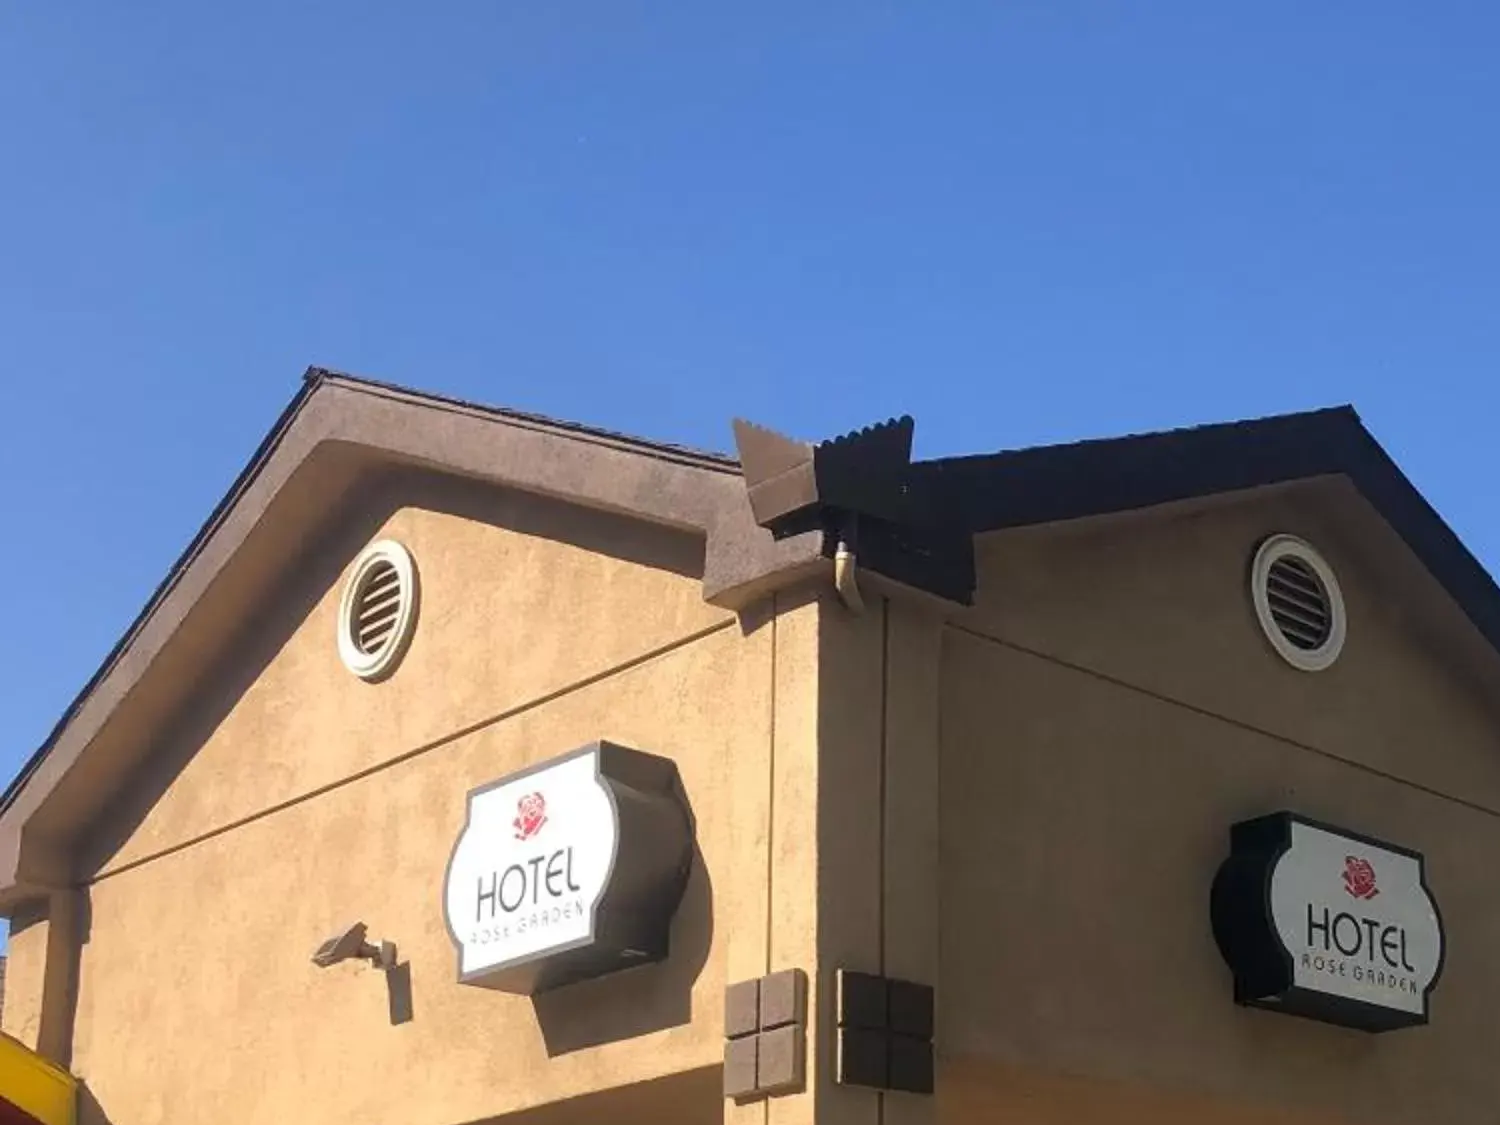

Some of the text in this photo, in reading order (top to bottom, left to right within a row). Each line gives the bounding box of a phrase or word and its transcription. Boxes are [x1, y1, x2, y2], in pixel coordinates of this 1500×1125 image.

[476, 846, 581, 922] HOTEL
[516, 897, 584, 934] GARDEN
[1307, 903, 1415, 972] HOTEL
[1301, 953, 1418, 994] ROSE GARDEN
